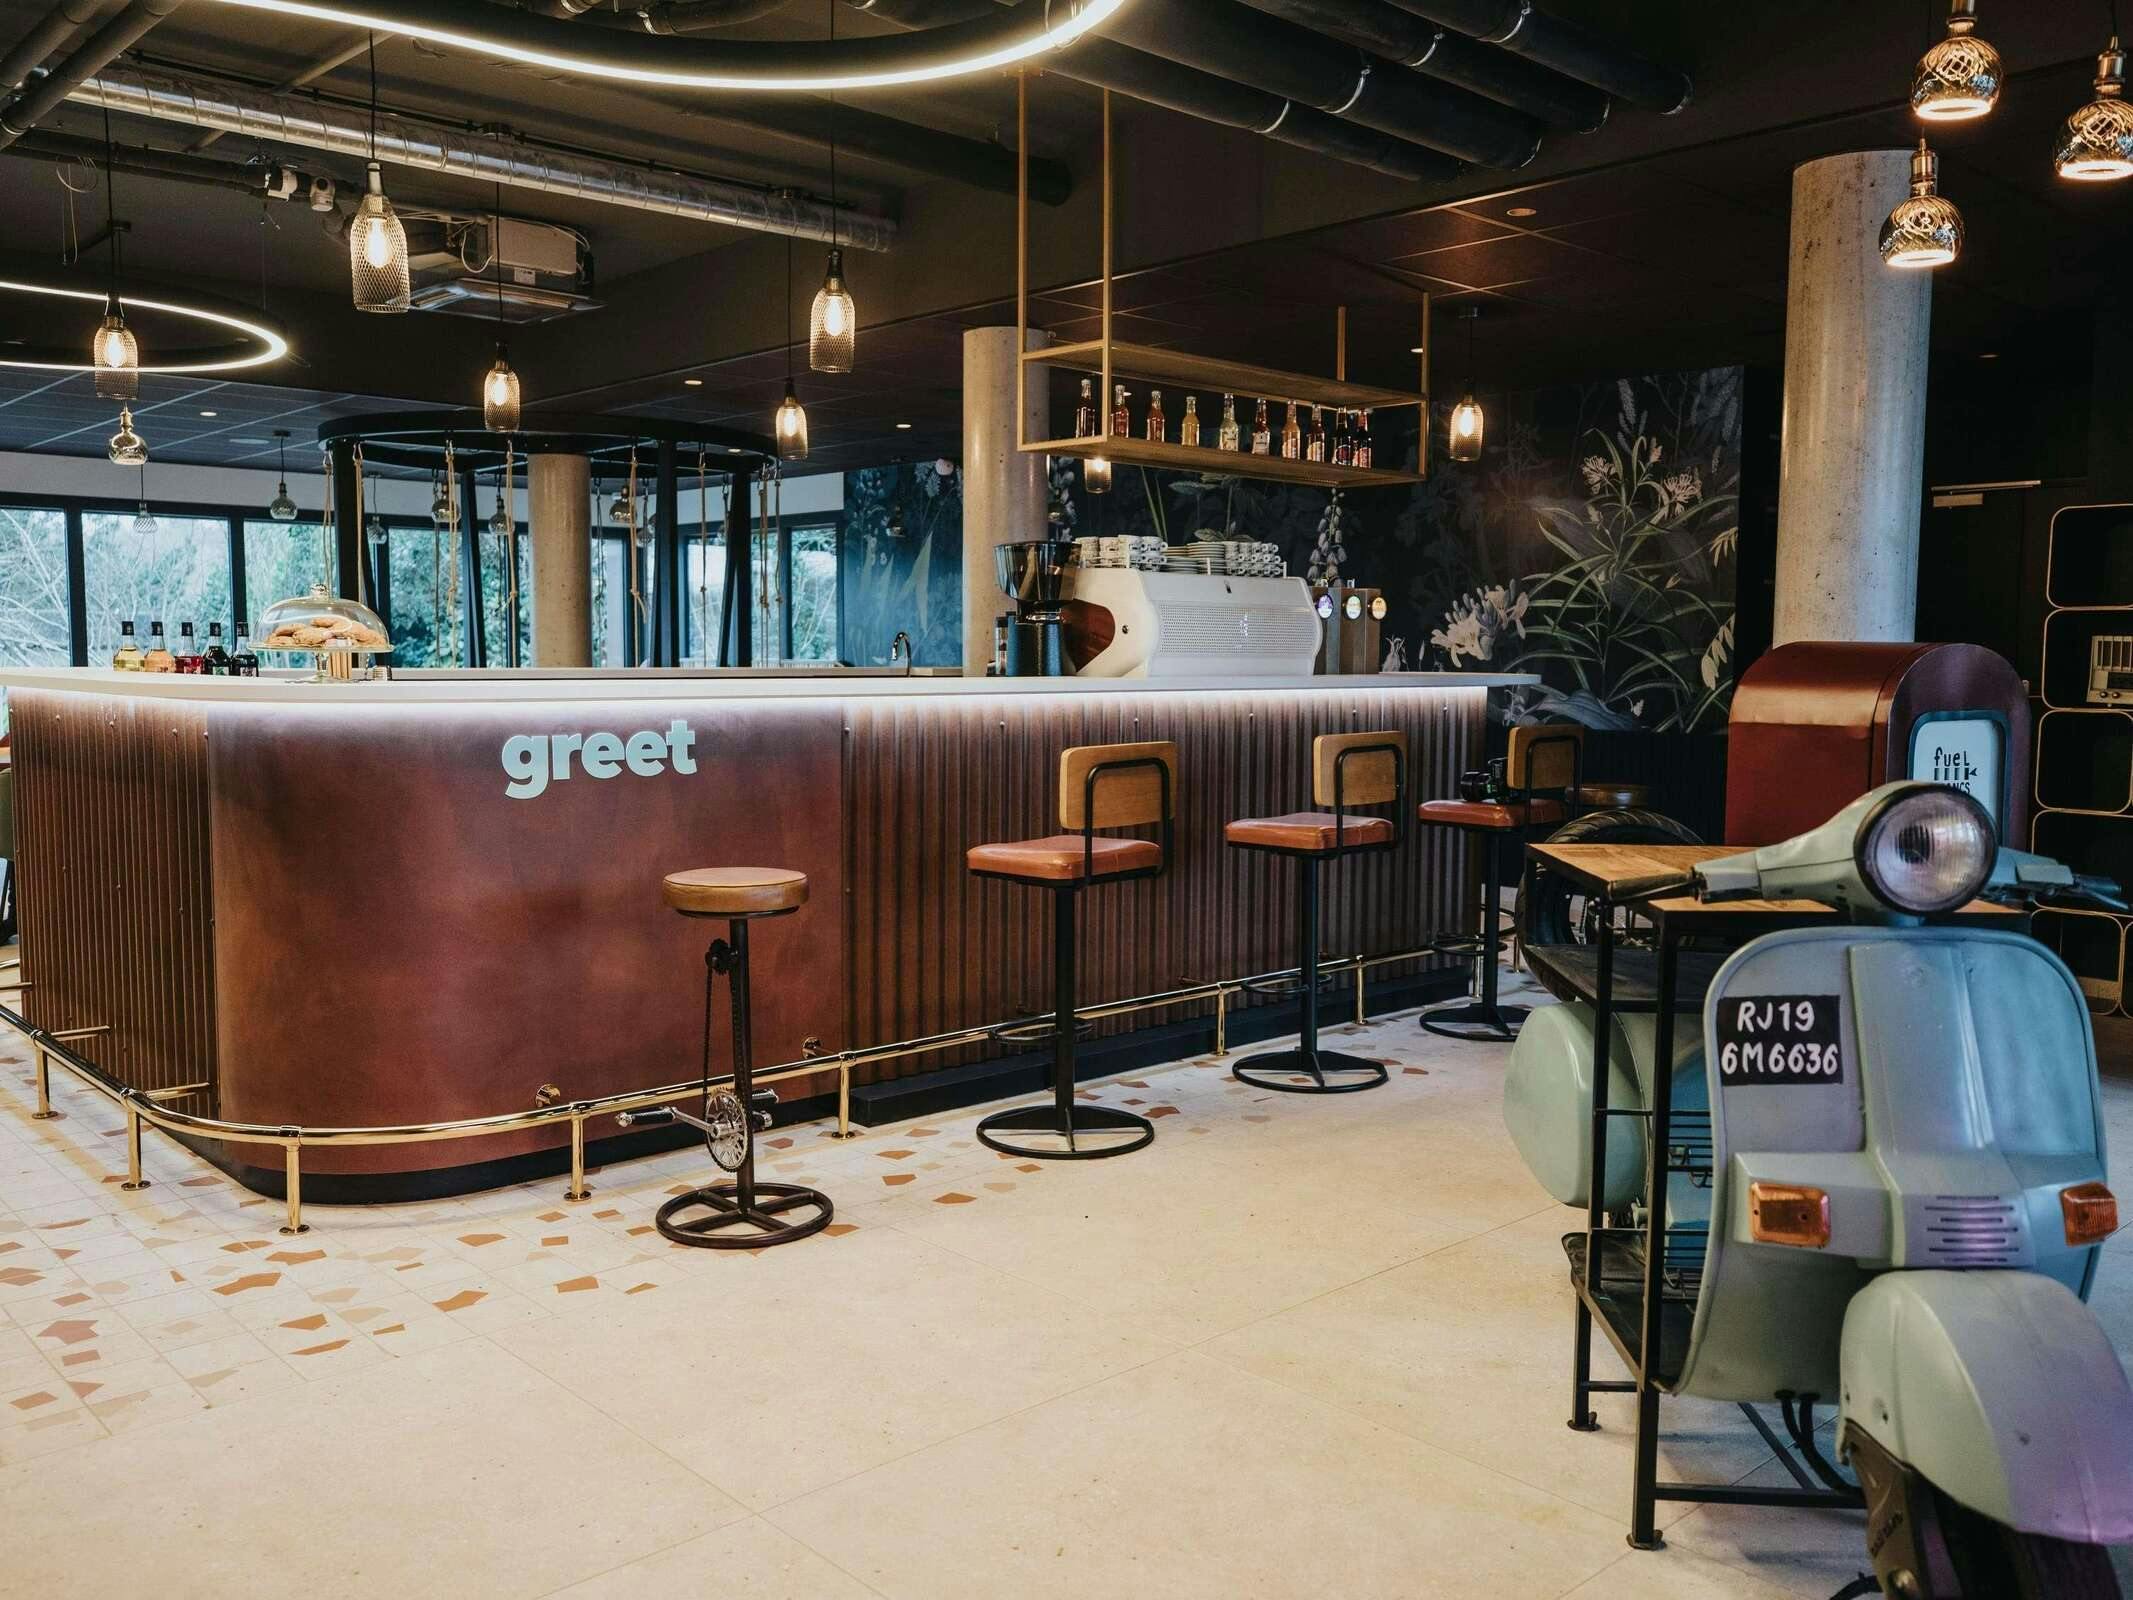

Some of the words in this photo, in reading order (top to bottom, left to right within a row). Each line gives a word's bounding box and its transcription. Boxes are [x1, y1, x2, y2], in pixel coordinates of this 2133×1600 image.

[502, 720, 697, 799] greet
[1934, 746, 1970, 767] fuel
[1737, 1001, 1815, 1032] RJ19
[1721, 1042, 1839, 1075] 6M6636
